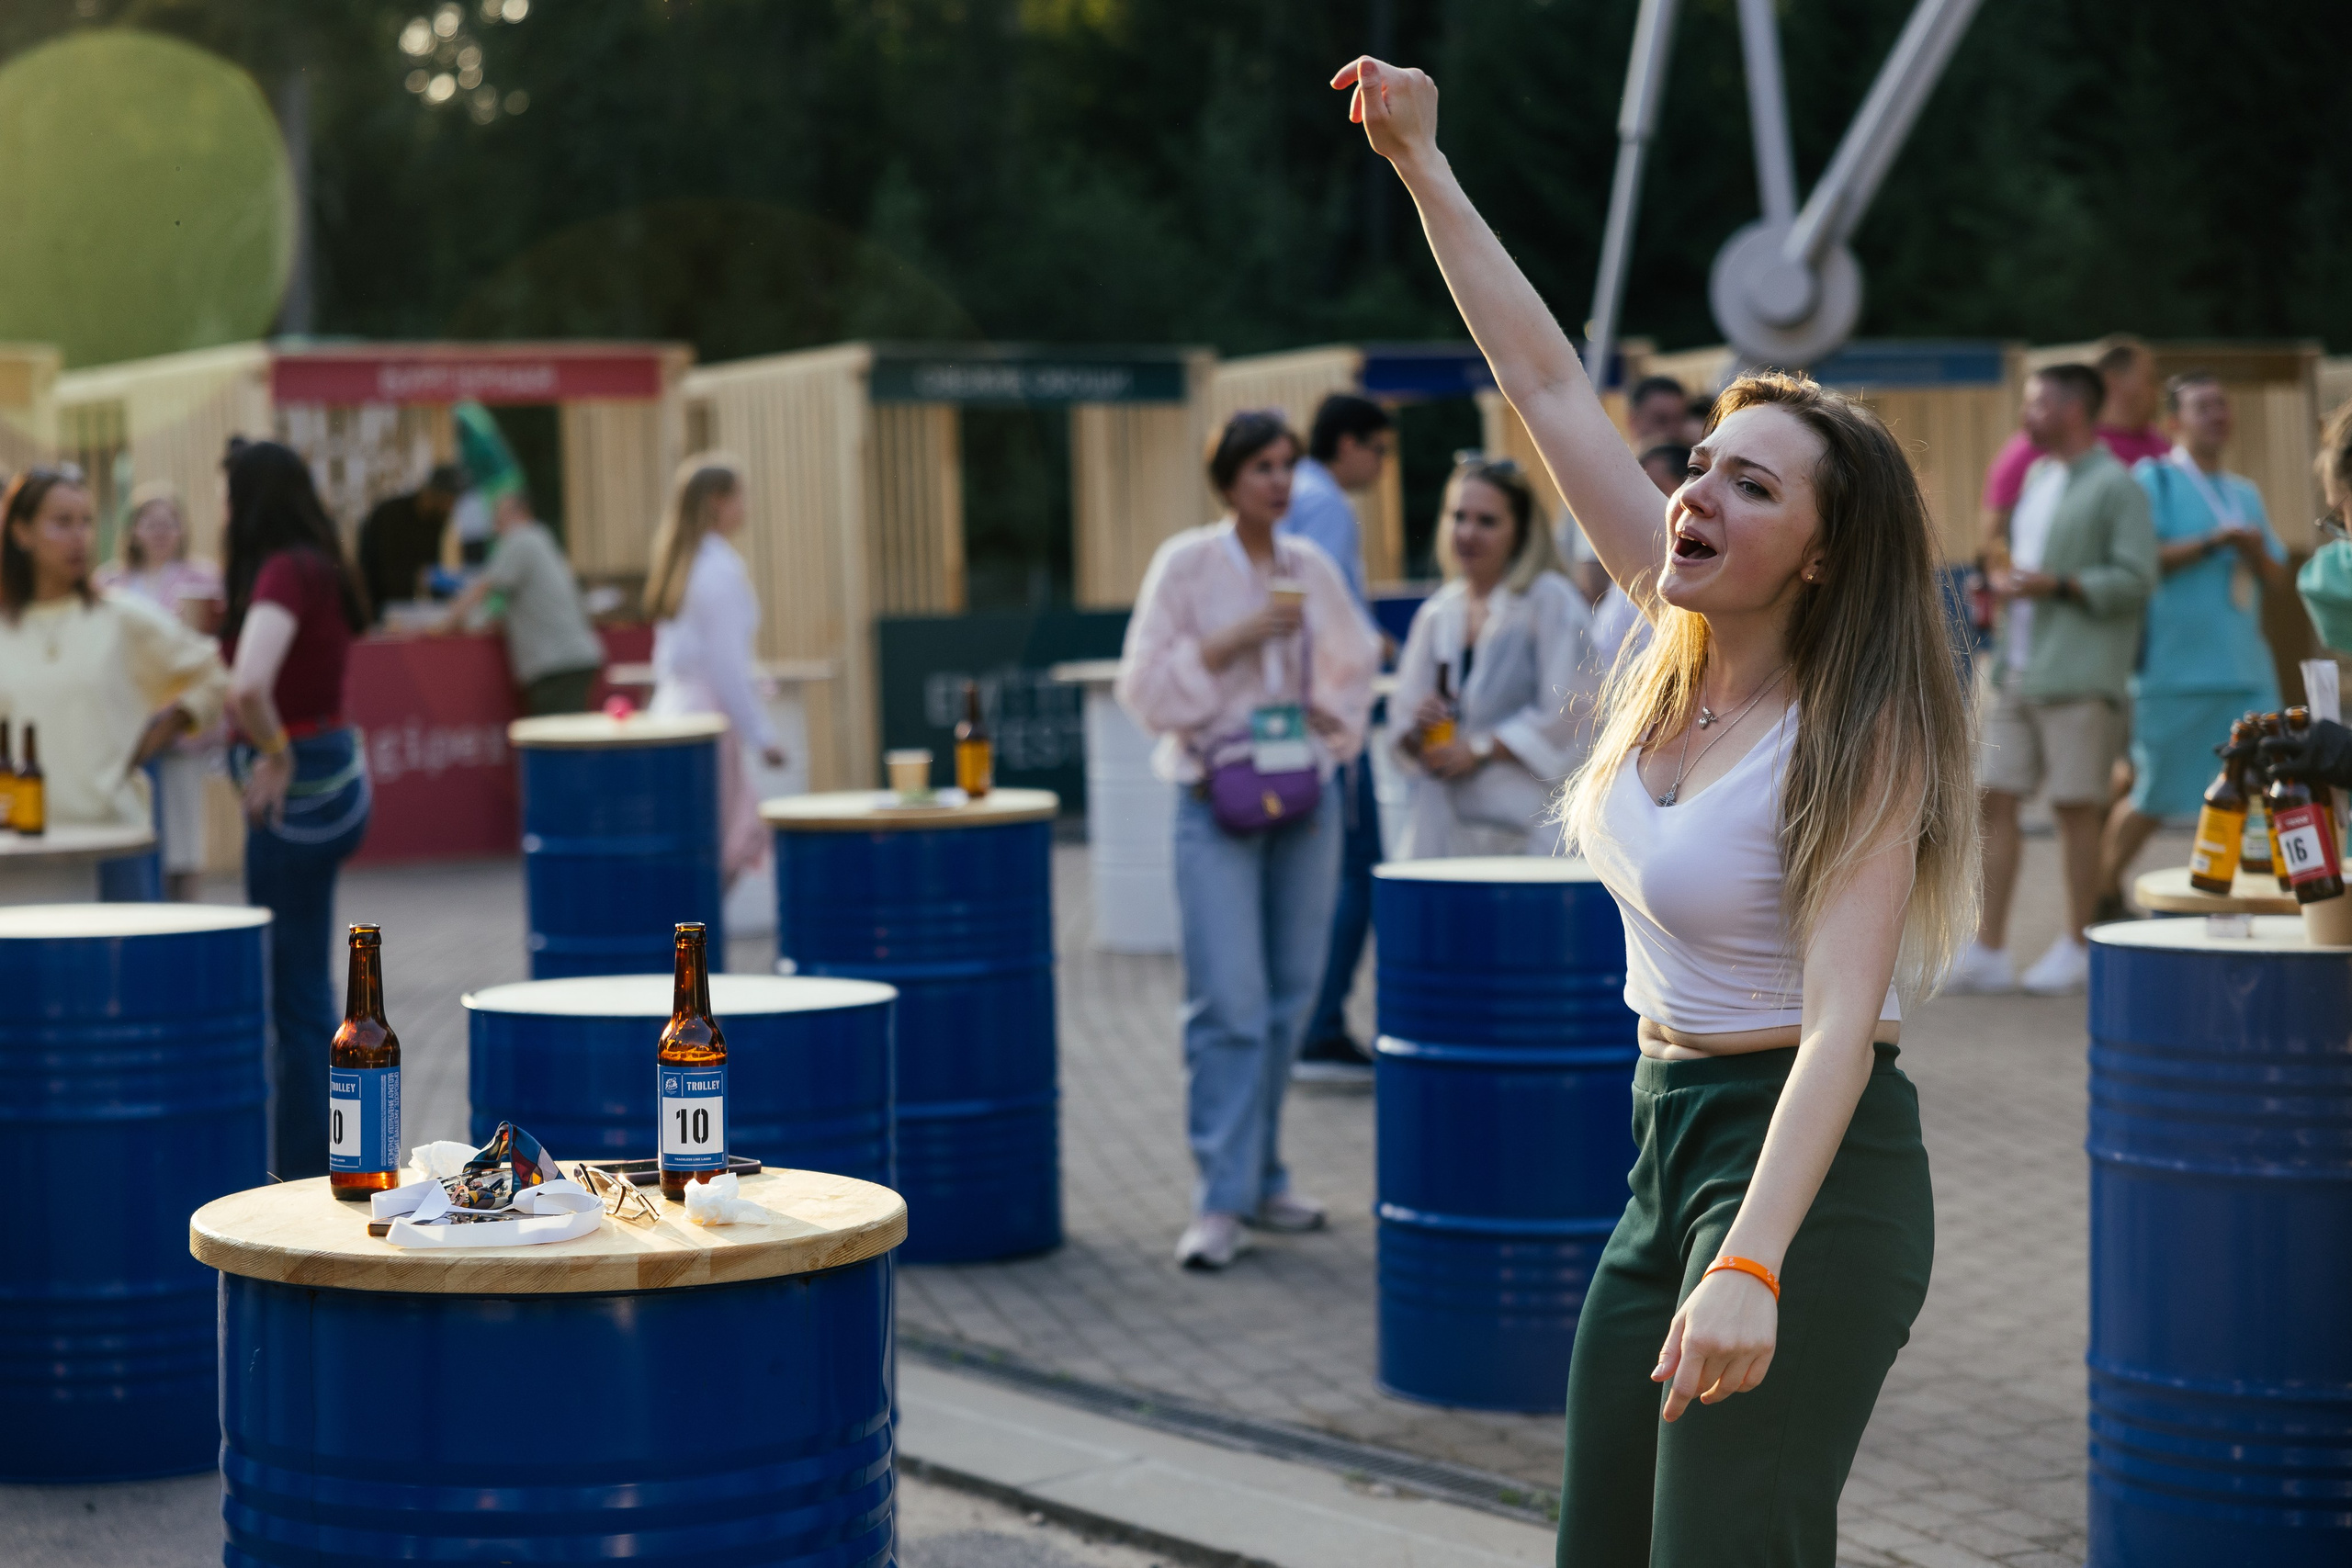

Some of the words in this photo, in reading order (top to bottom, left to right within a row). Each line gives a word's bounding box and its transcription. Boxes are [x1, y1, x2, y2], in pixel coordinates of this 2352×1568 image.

[2286, 836, 2308, 865] 16
[686, 1080, 720, 1091] TROLLEY
[330, 1108, 344, 1145] 0
[675, 1108, 709, 1145] 10
